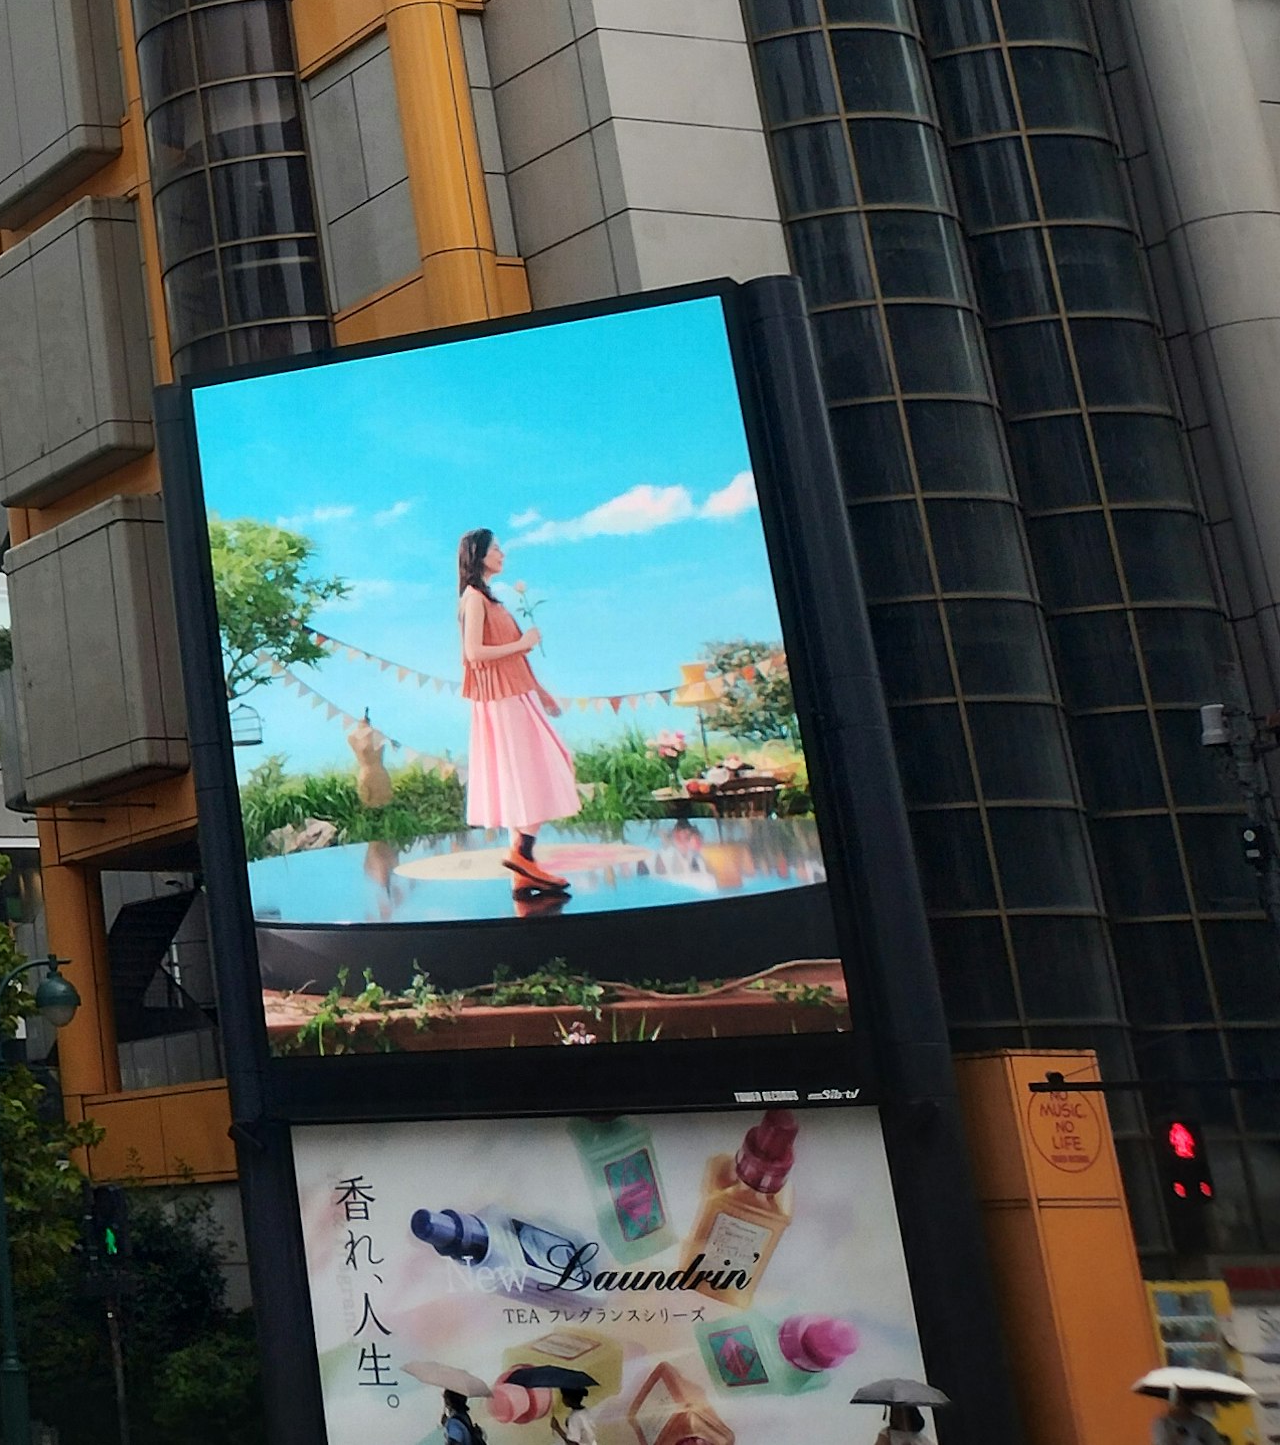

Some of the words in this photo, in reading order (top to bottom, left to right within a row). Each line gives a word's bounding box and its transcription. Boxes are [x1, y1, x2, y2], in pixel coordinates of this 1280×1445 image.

[1054, 1120, 1075, 1133] NO
[446, 1255, 527, 1295] New
[503, 1307, 541, 1325] TEA
[549, 1305, 706, 1325] フレグランスシリーズ
